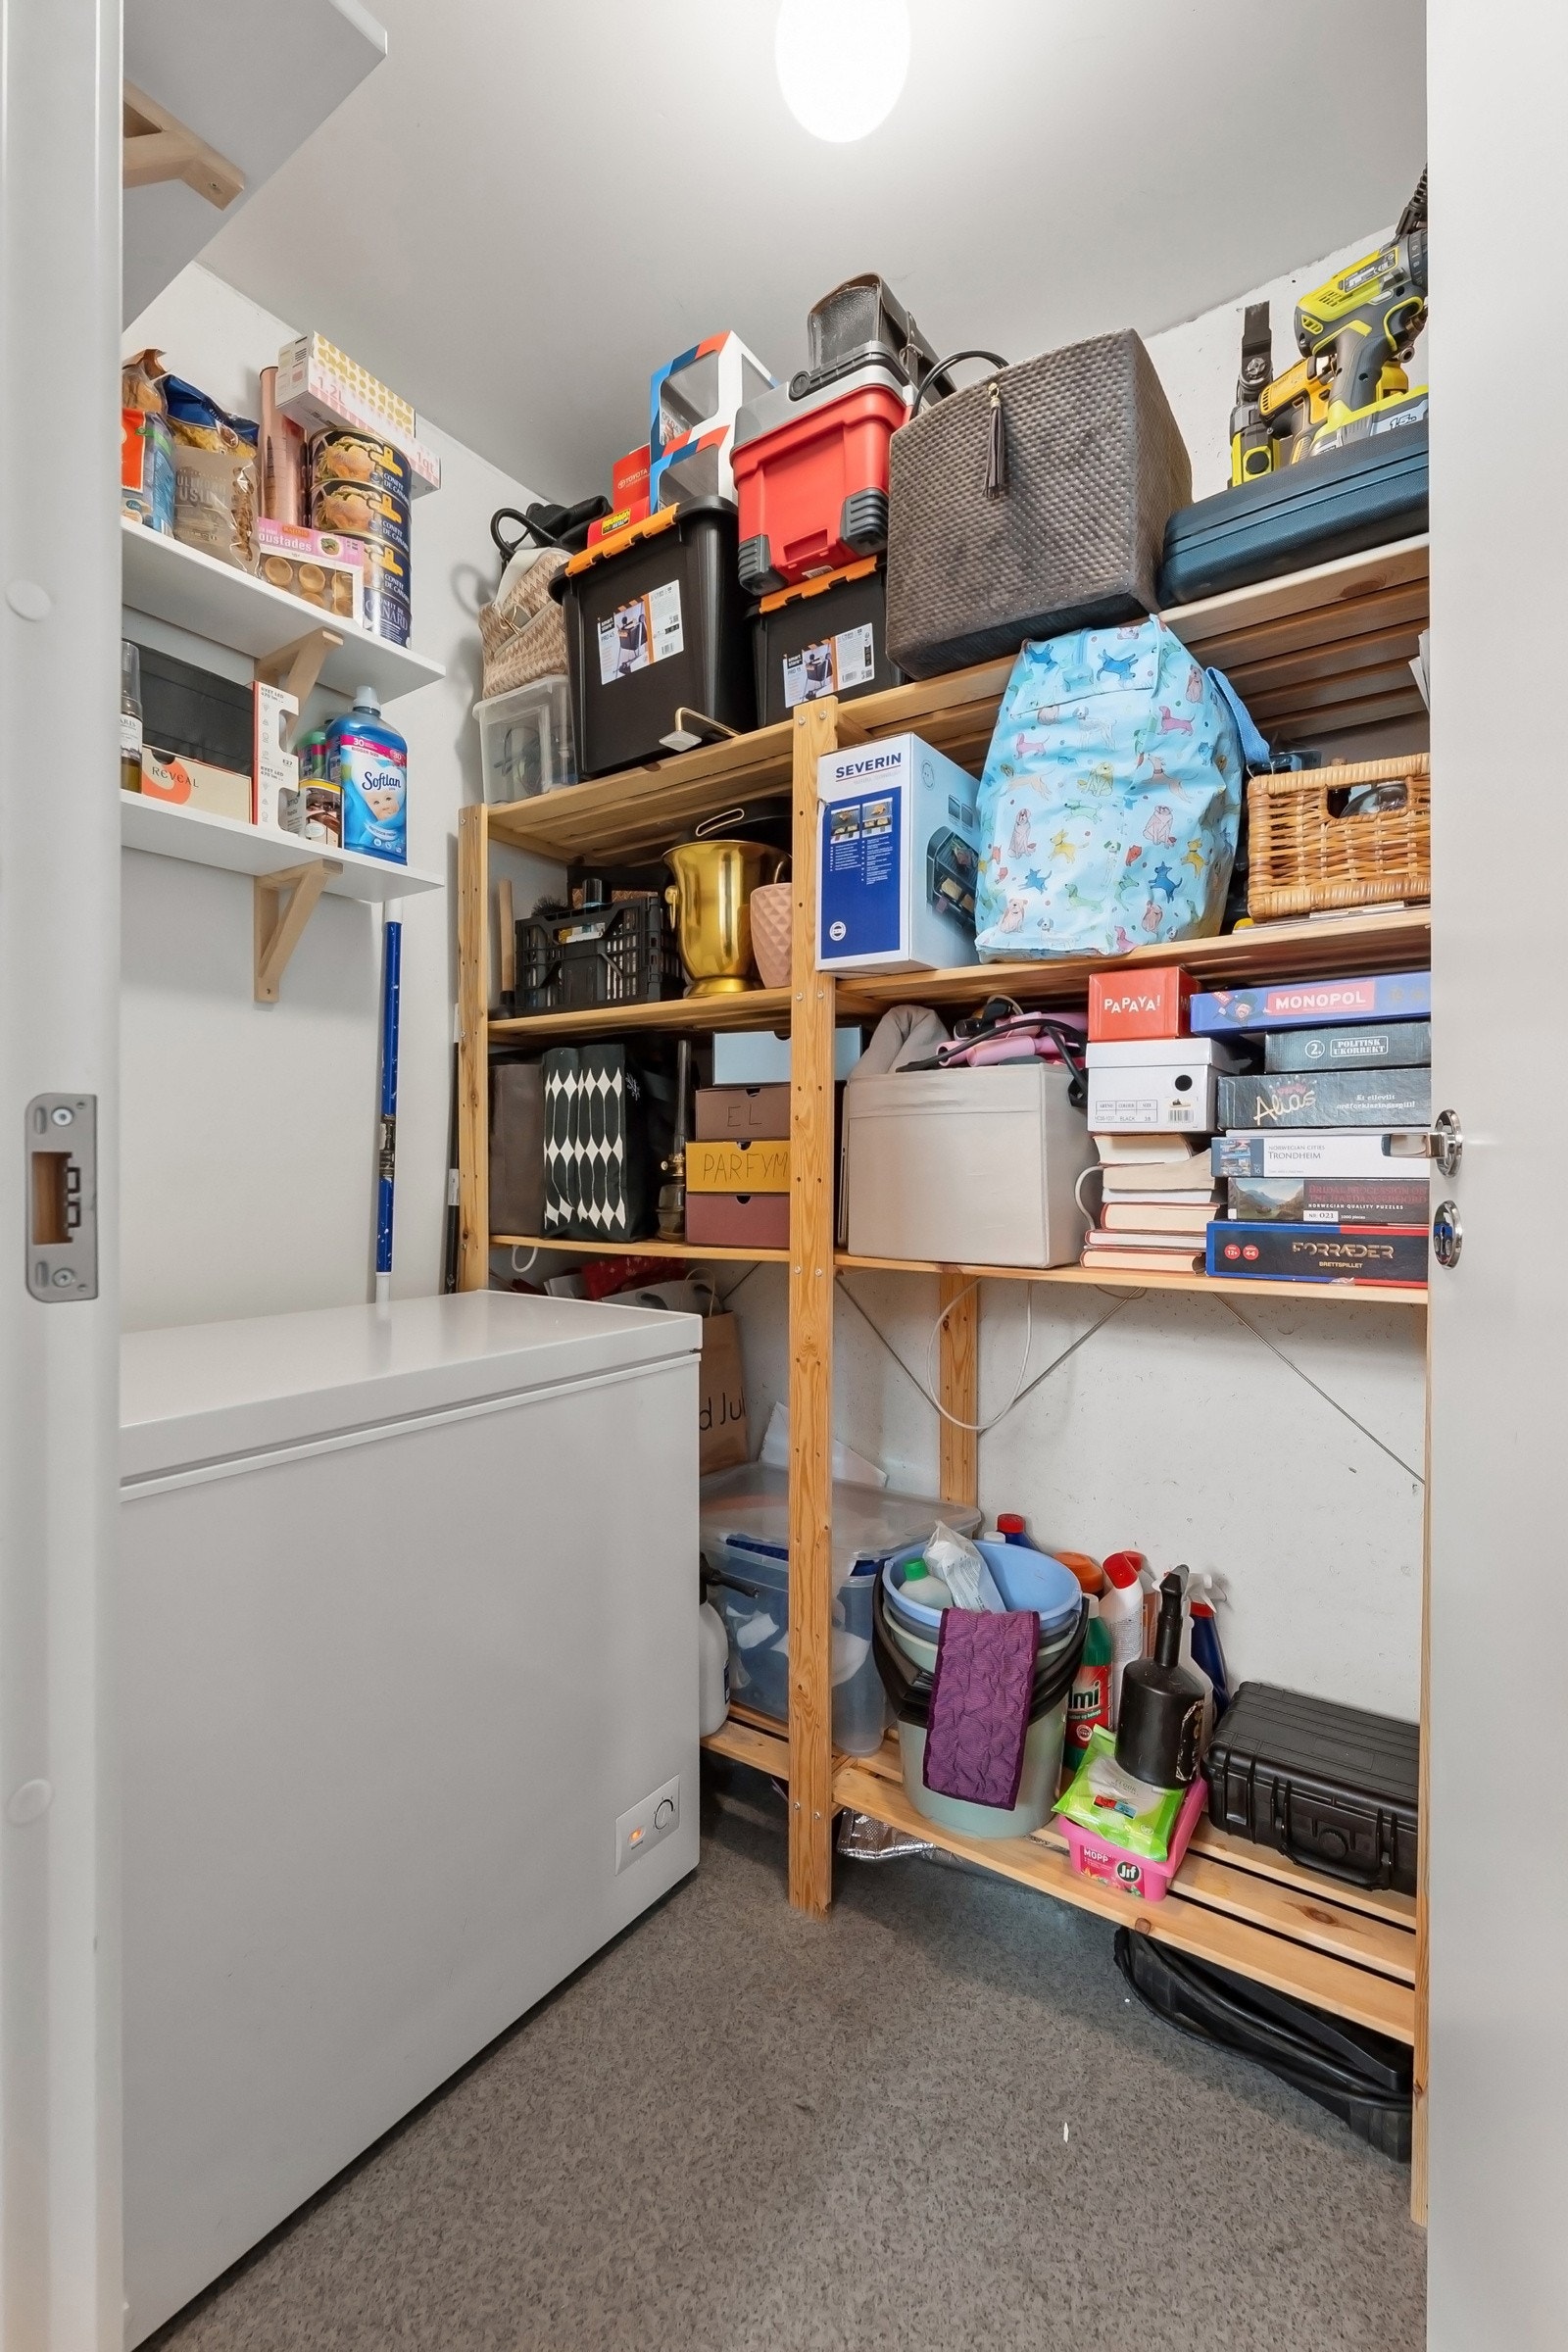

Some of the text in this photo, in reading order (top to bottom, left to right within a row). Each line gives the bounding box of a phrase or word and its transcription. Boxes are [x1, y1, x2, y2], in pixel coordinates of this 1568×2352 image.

[625, 468, 648, 485] TOYOTA
[354, 737, 365, 747] 30
[835, 752, 902, 779] SEVERIN
[362, 771, 402, 791] Softlan
[1103, 994, 1161, 1014] PAPAYA!
[1275, 992, 1366, 1010] MONOPOL
[1334, 1045, 1386, 1055] UKORREKT
[1337, 1038, 1382, 1049] POLITISK
[727, 1104, 762, 1127] EL
[1252, 1089, 1317, 1126] Alias
[1268, 1151, 1321, 1159] TRONDHEIM
[703, 1151, 789, 1184] PARFYM
[1292, 1242, 1395, 1259] FORRÆDER
[1084, 1847, 1109, 1863] MOPP
[1119, 1867, 1137, 1879] Jif
